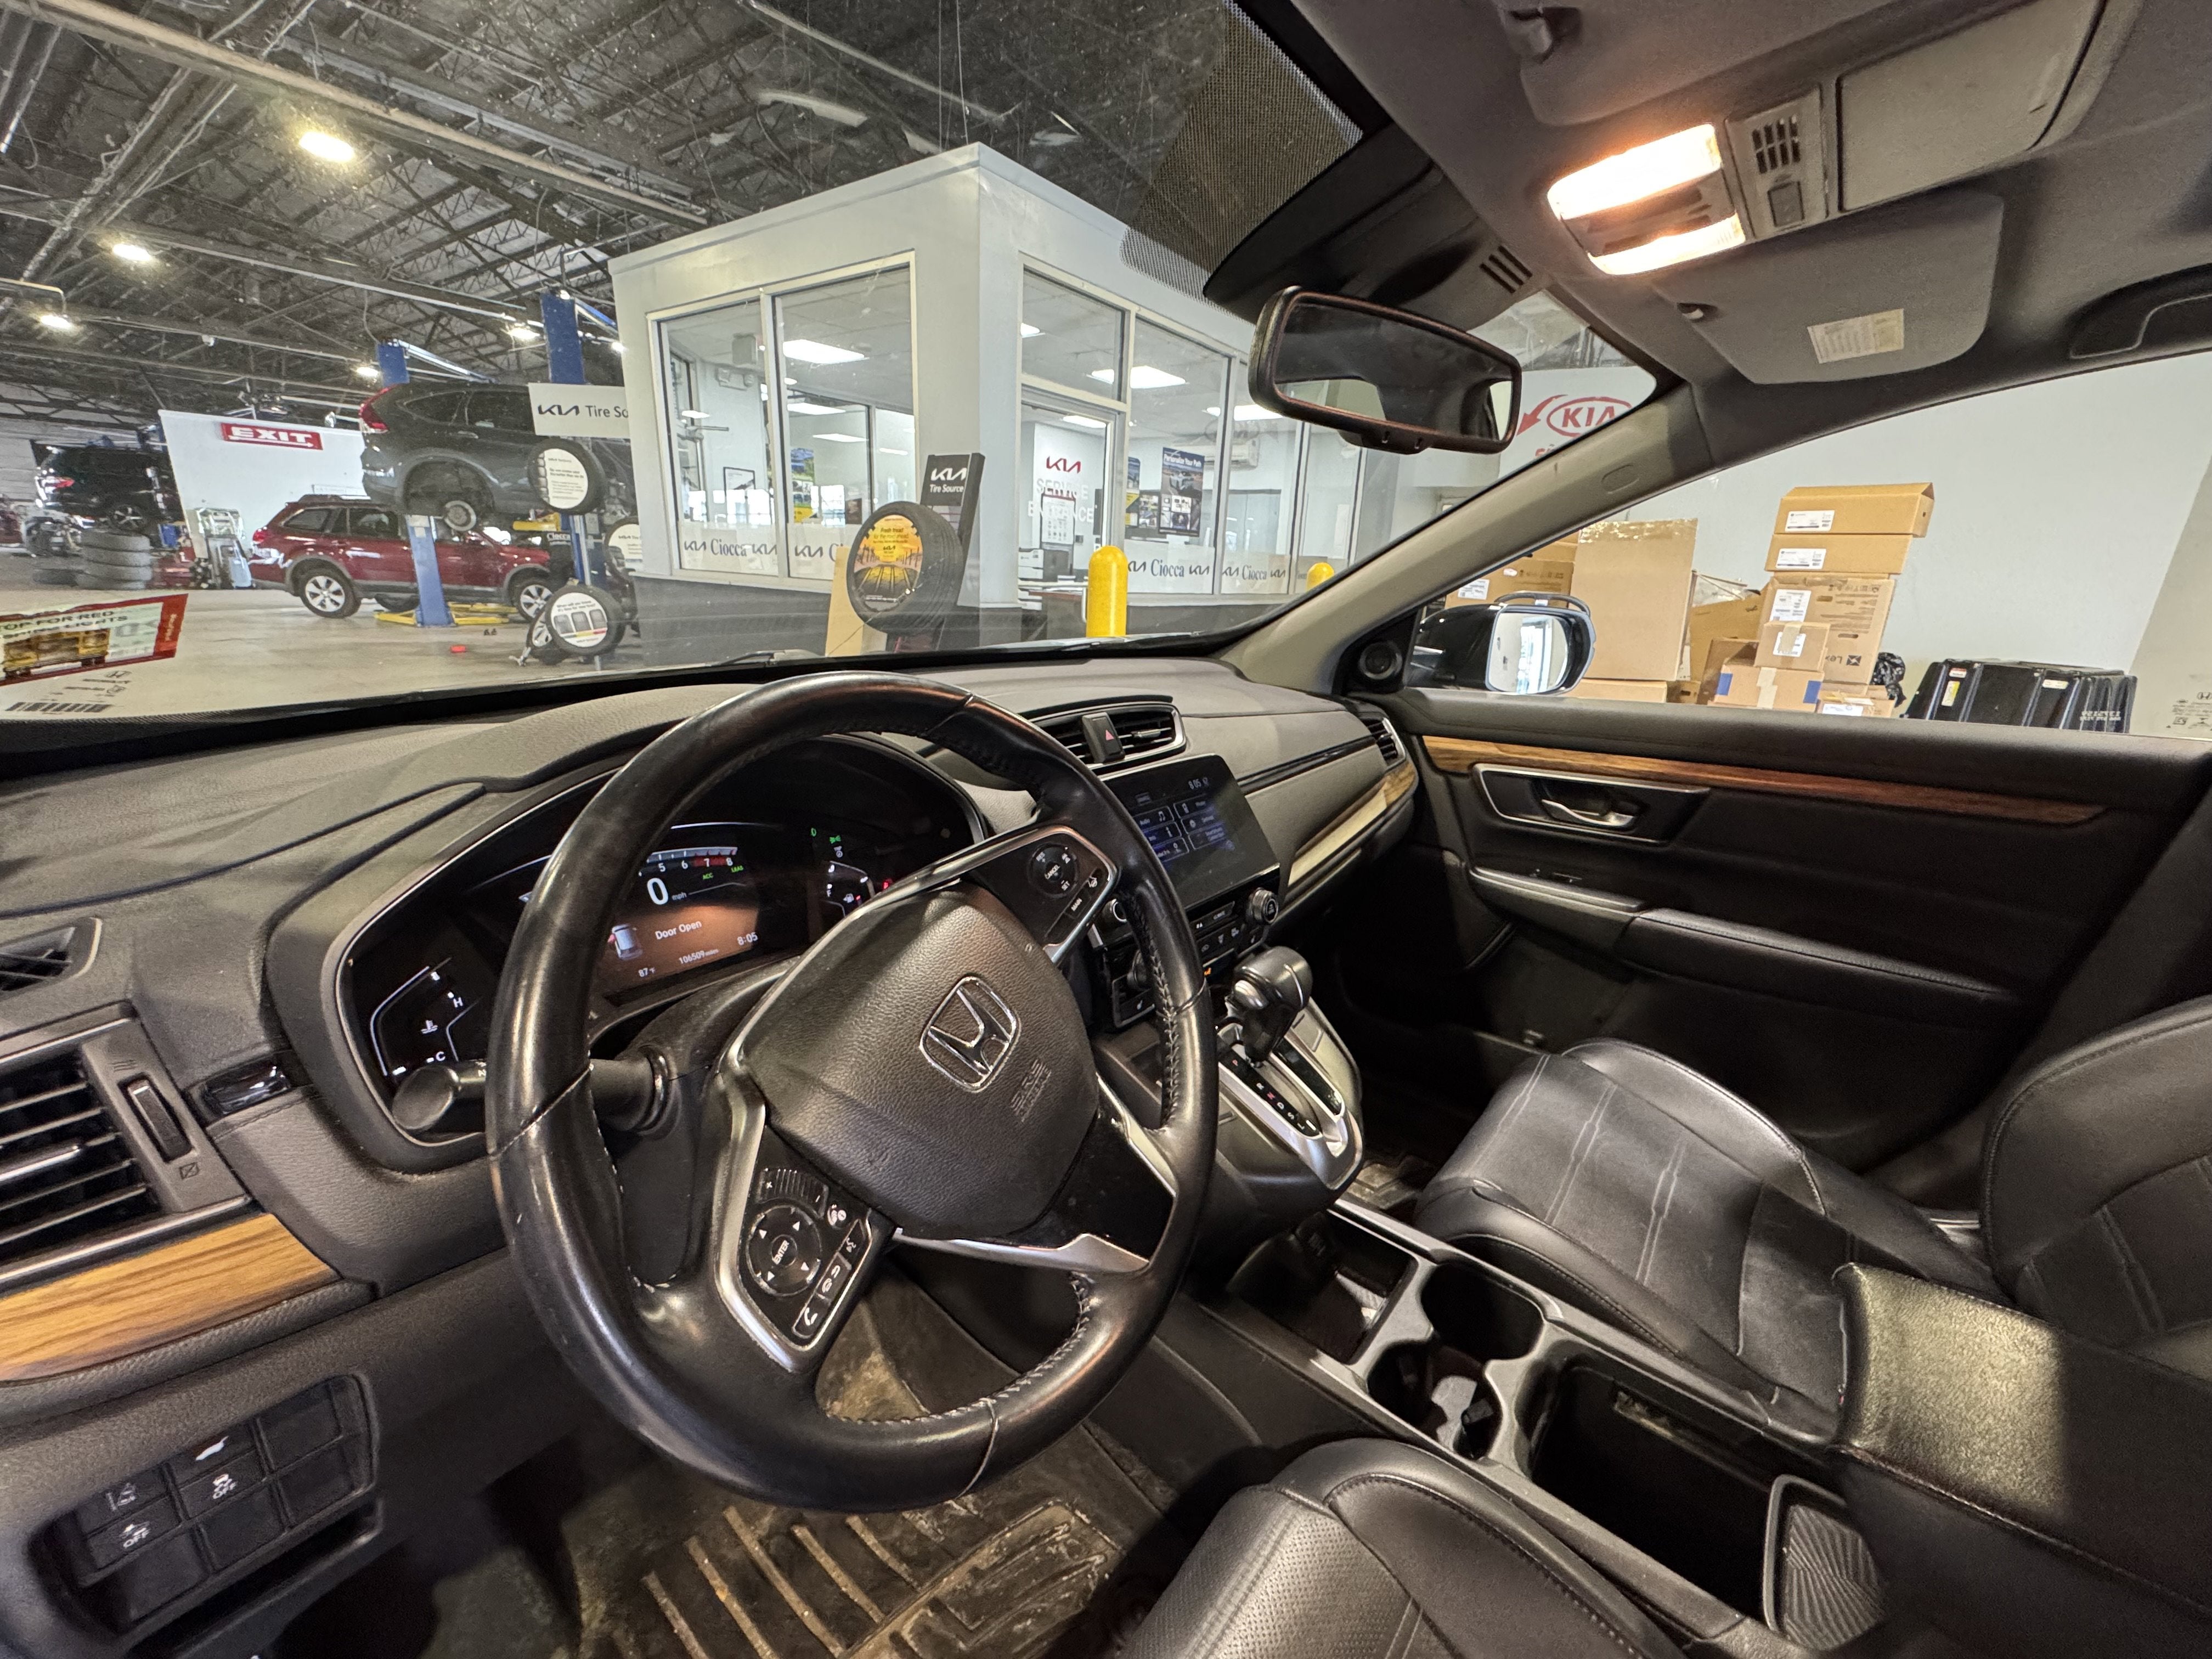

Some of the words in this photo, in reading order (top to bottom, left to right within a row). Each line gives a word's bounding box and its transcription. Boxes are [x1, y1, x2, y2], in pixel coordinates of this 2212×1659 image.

[538, 404, 580, 416] KIA
[585, 405, 610, 417] Tire
[1562, 406, 1615, 428] KIA
[231, 426, 312, 443] EXIT
[1046, 456, 1081, 473] KIA
[1193, 459, 1201, 467] Path
[931, 468, 967, 481] KIA
[929, 484, 941, 493] Tire
[942, 484, 964, 493] Source
[684, 540, 706, 551] KIA
[710, 538, 747, 556] Ciocca
[795, 545, 823, 558] KIA
[1151, 559, 1184, 577] Ciocca
[1189, 565, 1210, 575] KIA
[1242, 564, 1267, 581] Ciocca
[36, 616, 73, 626] FOR
[78, 611, 114, 620] RED
[659, 862, 665, 872] 5
[681, 860, 689, 870] 6
[704, 857, 710, 867] 7
[726, 857, 733, 866] 8
[1044, 864, 1061, 880] CANCEL
[647, 877, 669, 905] 0
[672, 891, 687, 901] mph
[1062, 880, 1070, 891] SET
[654, 927, 677, 940] Door
[679, 921, 702, 933] Open
[737, 932, 758, 946] 8:05
[453, 996, 463, 1008] H
[435, 1051, 446, 1062] C
[1256, 1082, 1264, 1090] R
[1277, 1102, 1285, 1110] D
[772, 1239, 790, 1265] ENTER
